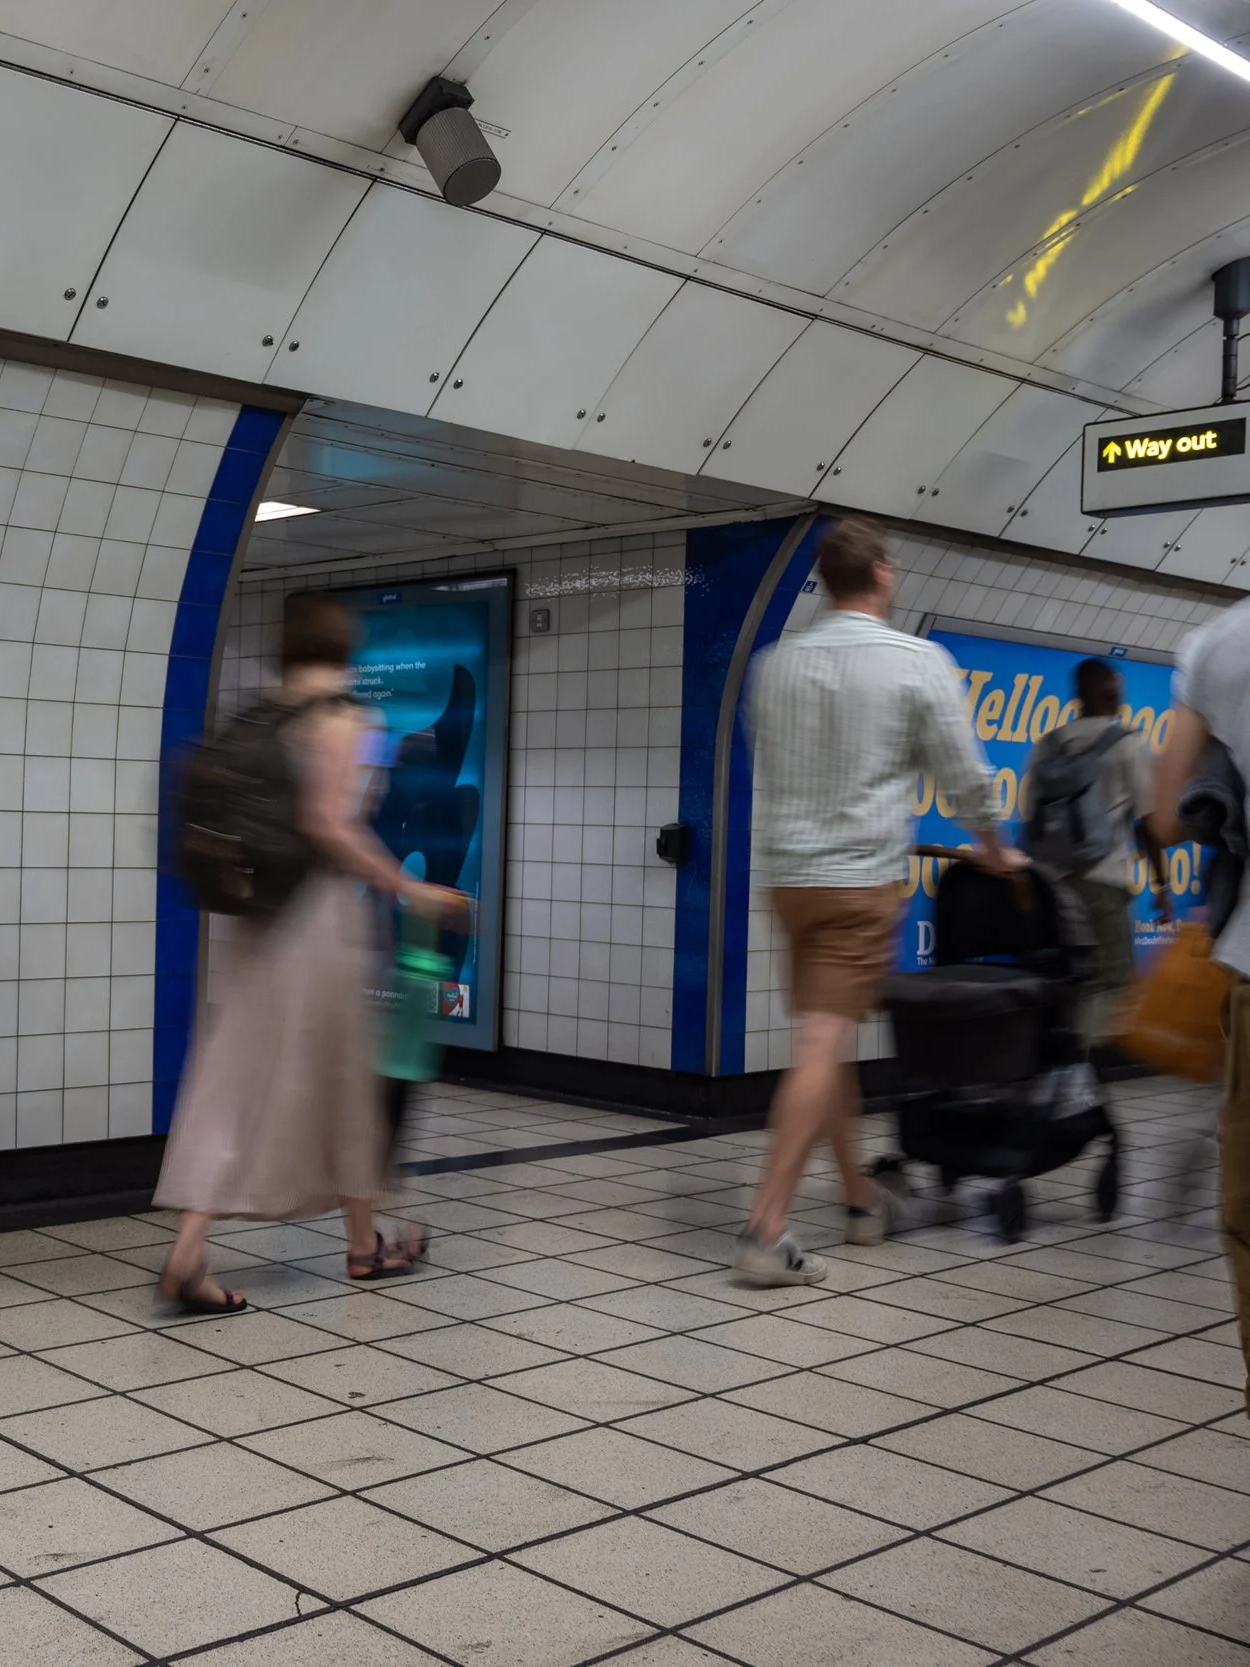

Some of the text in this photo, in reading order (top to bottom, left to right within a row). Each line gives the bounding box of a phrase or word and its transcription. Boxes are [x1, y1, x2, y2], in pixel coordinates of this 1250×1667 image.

[1124, 430, 1218, 460] Way out
[358, 663, 394, 673] babysitting
[395, 661, 414, 671] when
[414, 661, 426, 669] the
